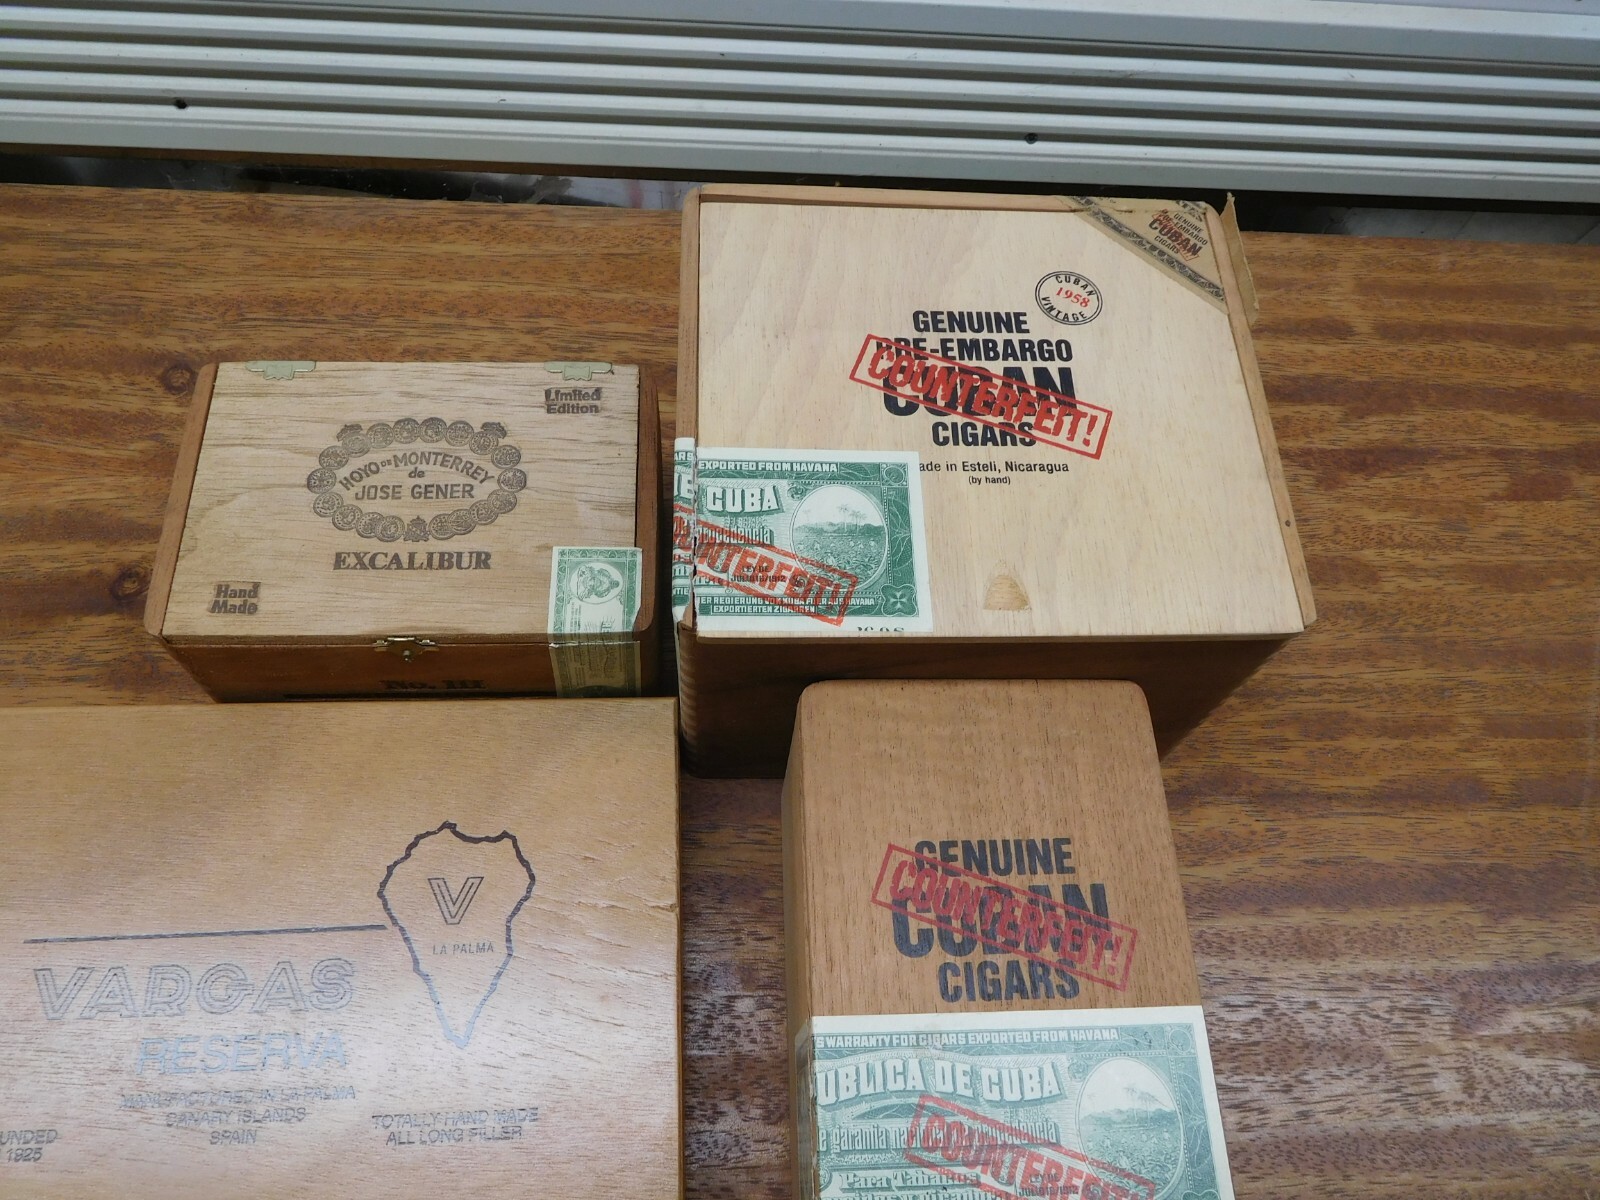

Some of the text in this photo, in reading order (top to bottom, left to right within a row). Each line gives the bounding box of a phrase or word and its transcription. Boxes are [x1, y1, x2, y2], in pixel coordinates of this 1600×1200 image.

[1173, 212, 1204, 233] GENUINE
[1149, 218, 1203, 256] CUBAN
[1154, 235, 1180, 254] CIGARS
[1055, 275, 1096, 297] CUBAN
[1056, 287, 1090, 307] 1958
[1041, 297, 1087, 322] VINTAGE
[912, 310, 1030, 334] GENUINE
[876, 337, 1073, 362] PRE-EMBARGO
[544, 387, 602, 402] Limited
[868, 347, 1098, 447] COUNTERFEIT!
[883, 366, 1078, 417] CUBAN
[546, 402, 600, 414] Edition
[932, 422, 1037, 447] CIGARS
[338, 451, 495, 491] HOYO DE MONTERREY
[408, 467, 425, 478] de
[698, 461, 838, 472] EXPORTED FROM HAVANA
[919, 461, 1070, 474] ade in Esteli, Nicaragua
[968, 475, 1011, 485] (by hand)
[355, 484, 475, 500] JOSE GENER
[706, 486, 781, 513] CUBA
[332, 551, 492, 570] EXCALIBUR
[215, 583, 260, 598] Hand
[210, 599, 258, 614] Made
[713, 605, 772, 613] EXPORTIERTEN
[914, 837, 1076, 877] GENUINE
[427, 876, 485, 925] V
[889, 860, 1124, 976] COUNTERFEIT!
[892, 883, 1116, 958] CUBAN
[433, 942, 494, 955] LA PALMA
[33, 957, 355, 1020] VARGAS
[938, 958, 1080, 1003] CIGARS
[826, 1035, 890, 1048] WARRANTY
[892, 1034, 917, 1047] FOR
[917, 1033, 966, 1046] CIGARS
[968, 1031, 1031, 1044] EXPORTED
[1032, 1029, 1068, 1042] FROM
[1070, 1028, 1118, 1041] HAVANA
[135, 1030, 349, 1075] RESERVA
[934, 1060, 975, 1098] DE
[980, 1061, 1064, 1101] CUBA
[238, 1107, 307, 1123] ISLANDS
[372, 1107, 538, 1130] TOTALLY HAND MADE
[210, 1129, 258, 1145] SPAIN
[386, 1125, 522, 1146] ALL LONG FILLER
[7, 1147, 43, 1162] 1825
